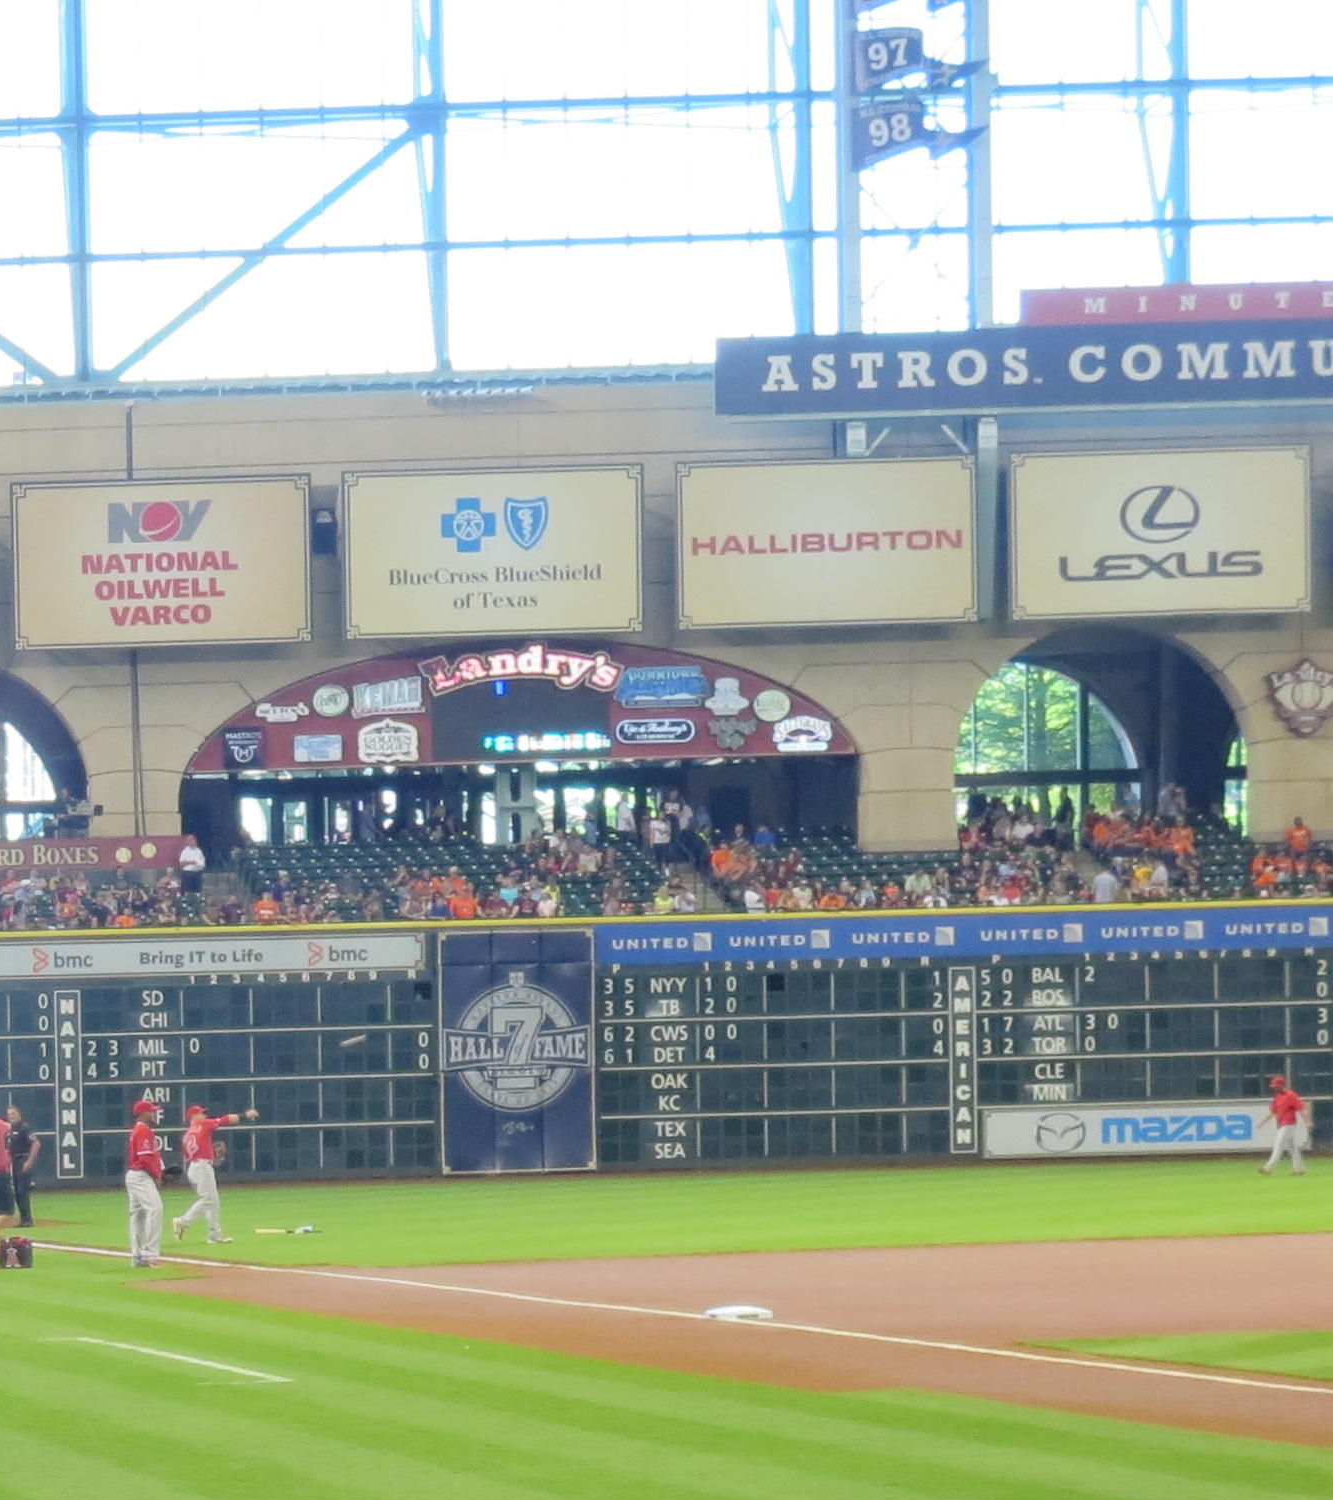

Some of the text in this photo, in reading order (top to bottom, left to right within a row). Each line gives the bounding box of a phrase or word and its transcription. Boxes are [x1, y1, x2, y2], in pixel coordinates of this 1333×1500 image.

[868, 38, 908, 71] 97
[868, 113, 912, 148] 98
[1084, 291, 1333, 315] MINUTE
[762, 348, 1030, 392] ASTROS
[691, 529, 963, 557] HALLIBURTON
[81, 550, 239, 575] NATIONAL
[1059, 550, 1263, 583] LEXUS
[389, 563, 602, 586] BlueCross BlueShield
[95, 577, 226, 601] OILWELL
[453, 592, 538, 610] of Texas
[109, 603, 212, 627] VARCO
[427, 645, 619, 691] Landry's
[32, 845, 99, 867] BOXES
[852, 932, 930, 944] UNITED
[981, 928, 1059, 941] UNITED
[1101, 925, 1180, 938] UNITED
[1226, 922, 1304, 935] UNITED
[612, 938, 688, 950] UNITED
[730, 935, 806, 946] UNITED
[53, 952, 93, 968] bmc
[139, 949, 264, 968] Bring IT to Life
[328, 946, 368, 962] bmc
[604, 971, 940, 994] 3 5 NYY 1 0 1
[981, 960, 1327, 985] 5 0 BAL 2 2
[38, 994, 48, 1009] 0
[141, 991, 164, 1006] SD
[604, 993, 943, 1016] 3 5 TB 2 0 2
[981, 982, 1328, 1007] 2 2 BOS 0
[38, 1016, 48, 1031] 0
[140, 1013, 168, 1028] CHI
[604, 1019, 944, 1042] 6 2 CWS 0 0 0
[983, 1009, 1328, 1033] 1 7 ATL 3 0 3
[87, 1033, 429, 1056] 2 3 MIL 0 0
[448, 1005, 586, 1066] HALL 7 FAME
[982, 1030, 1328, 1055] 3 2 TOR 0 0
[40, 1043, 47, 1057] 1
[604, 1040, 944, 1064] 6 1 DET 4 4
[954, 976, 972, 1144] AMERICAN
[39, 1065, 49, 1080] 0
[87, 1055, 429, 1079] 4 5 PIT 0
[1034, 1063, 1064, 1079] CLE
[60, 999, 76, 1169] NATIONAL
[651, 1074, 688, 1089] OAK
[1032, 1085, 1066, 1101] MIN
[142, 1087, 171, 1103] ARI
[659, 1095, 681, 1111] KC
[654, 1121, 686, 1137] TEX
[1101, 1115, 1253, 1144] mazda
[654, 1143, 686, 1159] SEA
